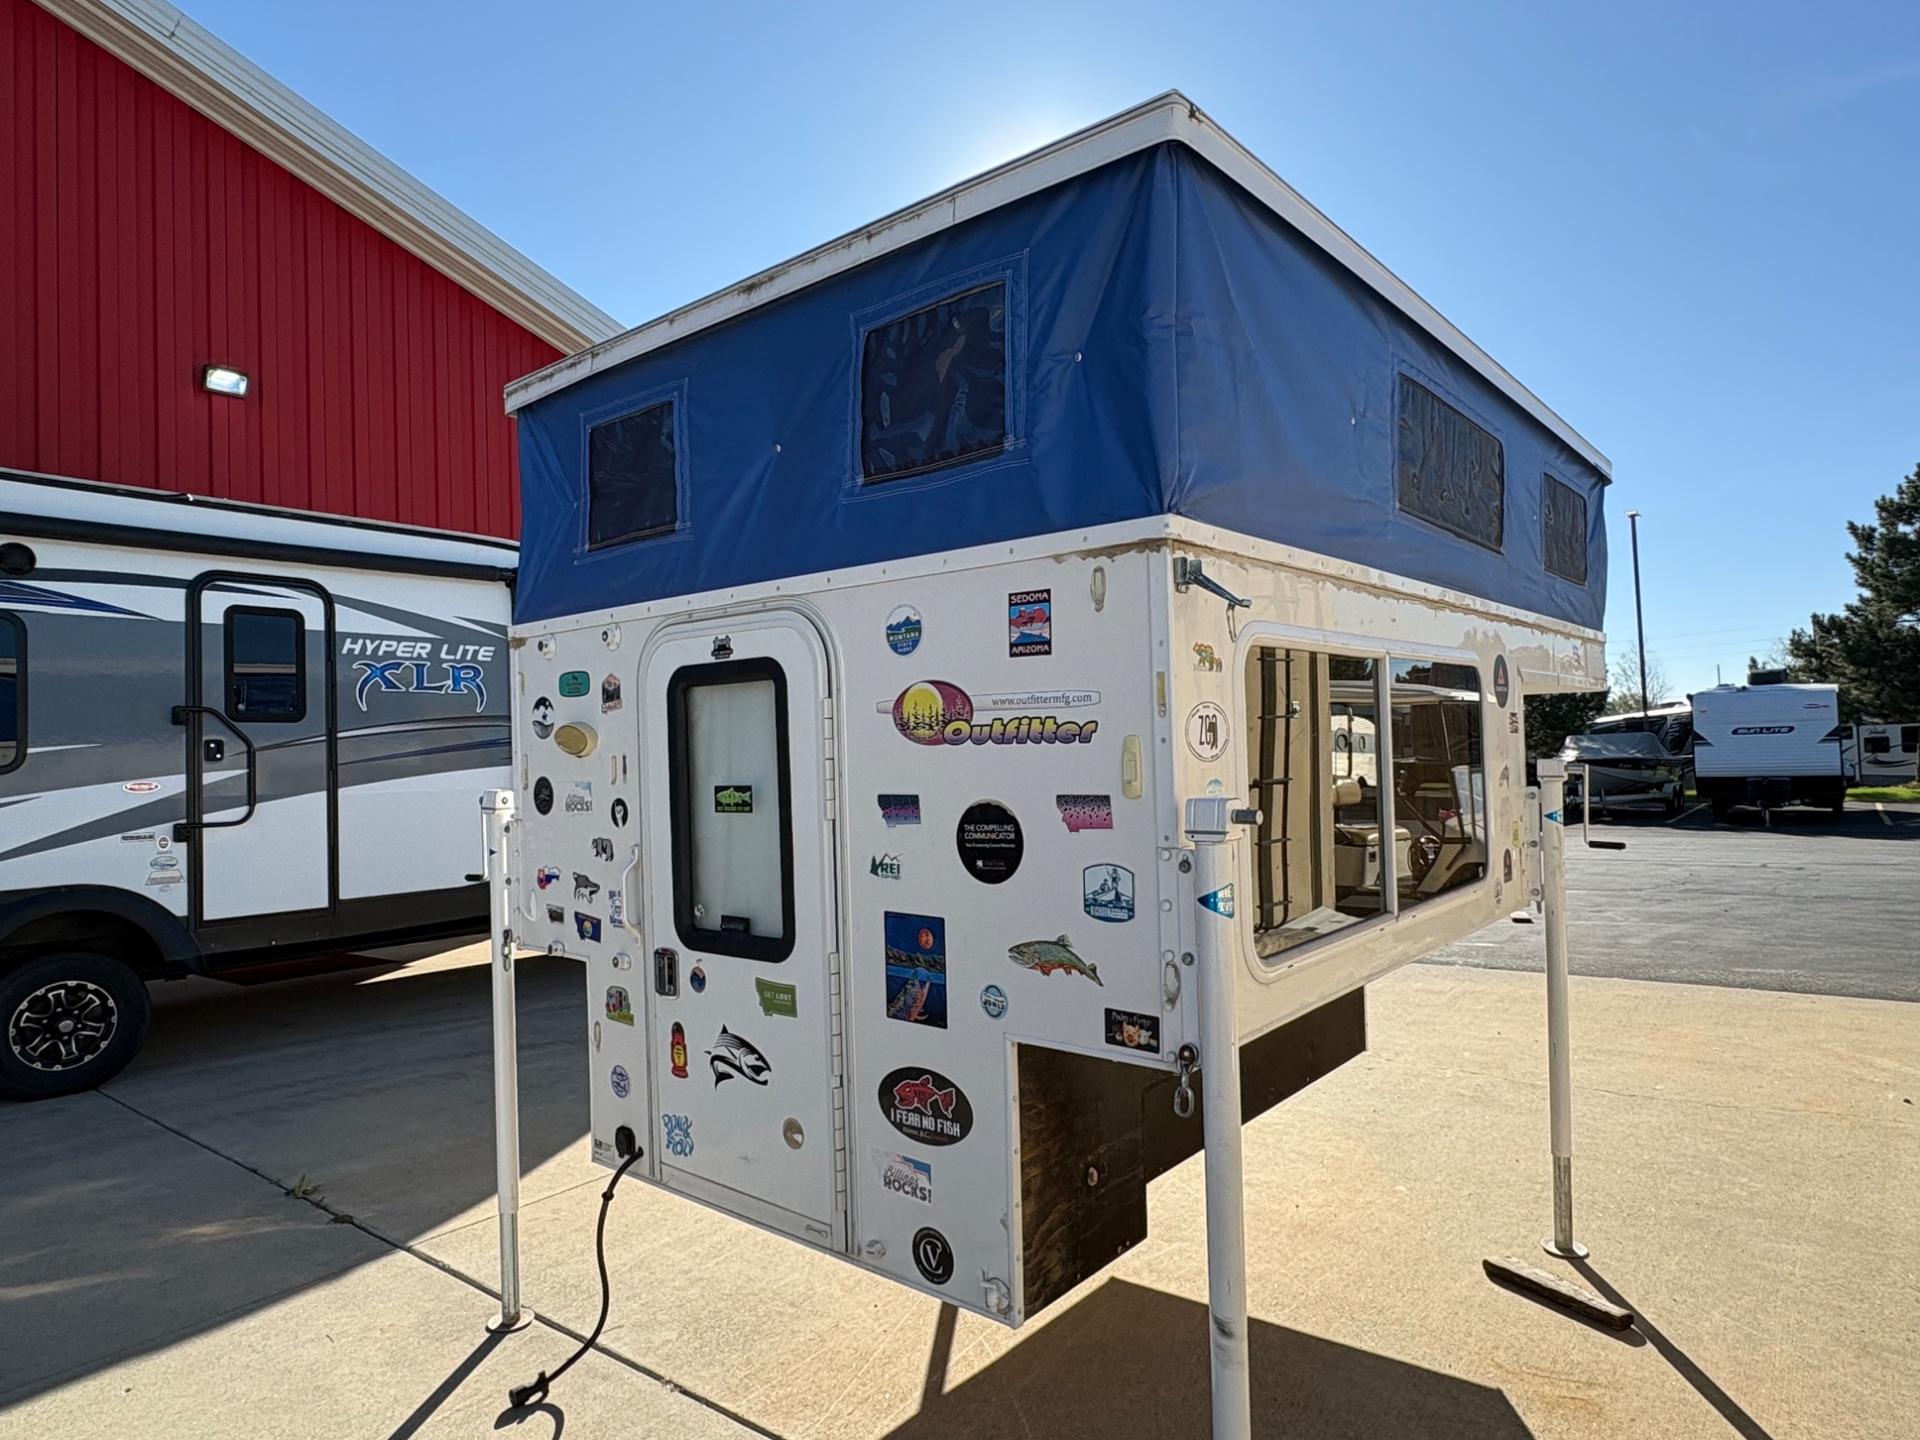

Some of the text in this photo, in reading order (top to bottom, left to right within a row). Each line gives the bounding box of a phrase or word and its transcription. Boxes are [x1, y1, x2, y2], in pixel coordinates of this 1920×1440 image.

[1010, 592, 1049, 604] SEDONA
[888, 631, 920, 641] MONTANA
[341, 638, 495, 662] HYPER LITE
[1011, 644, 1050, 655] ARIZONA
[352, 659, 487, 713] XLR
[992, 693, 1092, 707] www.outfittermfg.com
[943, 715, 1098, 746] Outfitter
[964, 823, 1015, 832] THE COMPELLING
[964, 832, 1016, 840] COMMUNICATOR
[880, 862, 900, 874] REI
[775, 992, 792, 1001] LOST
[890, 1107, 895, 1122] I
[896, 1109, 921, 1128] FEAR
[921, 1114, 936, 1131] NO
[937, 1118, 961, 1137] FISH
[883, 1174, 932, 1204] ROCKS!
